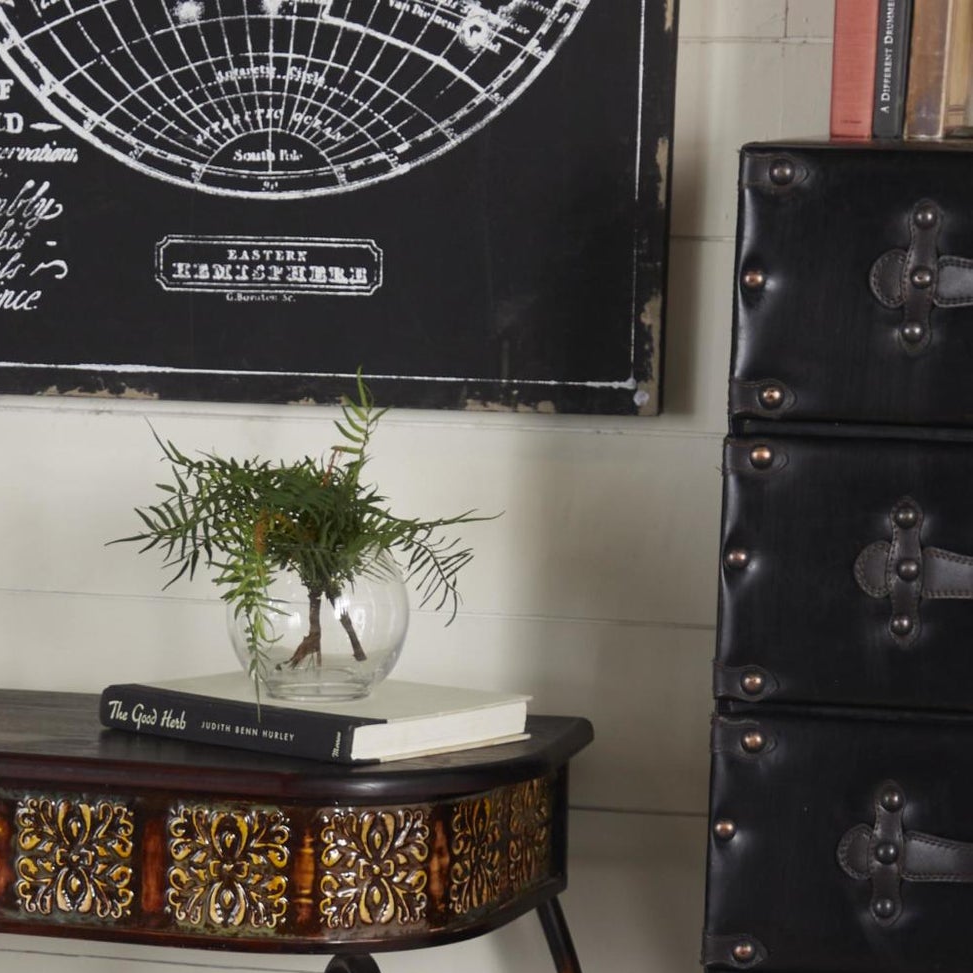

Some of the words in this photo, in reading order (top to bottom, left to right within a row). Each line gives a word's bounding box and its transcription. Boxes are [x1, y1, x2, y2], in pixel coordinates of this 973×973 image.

[884, 0, 895, 45] DRUMME
[880, 47, 893, 102] DIFFERENT
[880, 105, 890, 114] A
[233, 149, 275, 162] South
[227, 249, 308, 262] EASTERN
[172, 261, 368, 285] HEMISPHERE
[108, 700, 129, 721] The
[131, 703, 158, 731] Good
[160, 708, 187, 730] Herb
[200, 721, 232, 733] JUDITH
[234, 725, 259, 737] BENN
[262, 730, 295, 742] HURLEY
